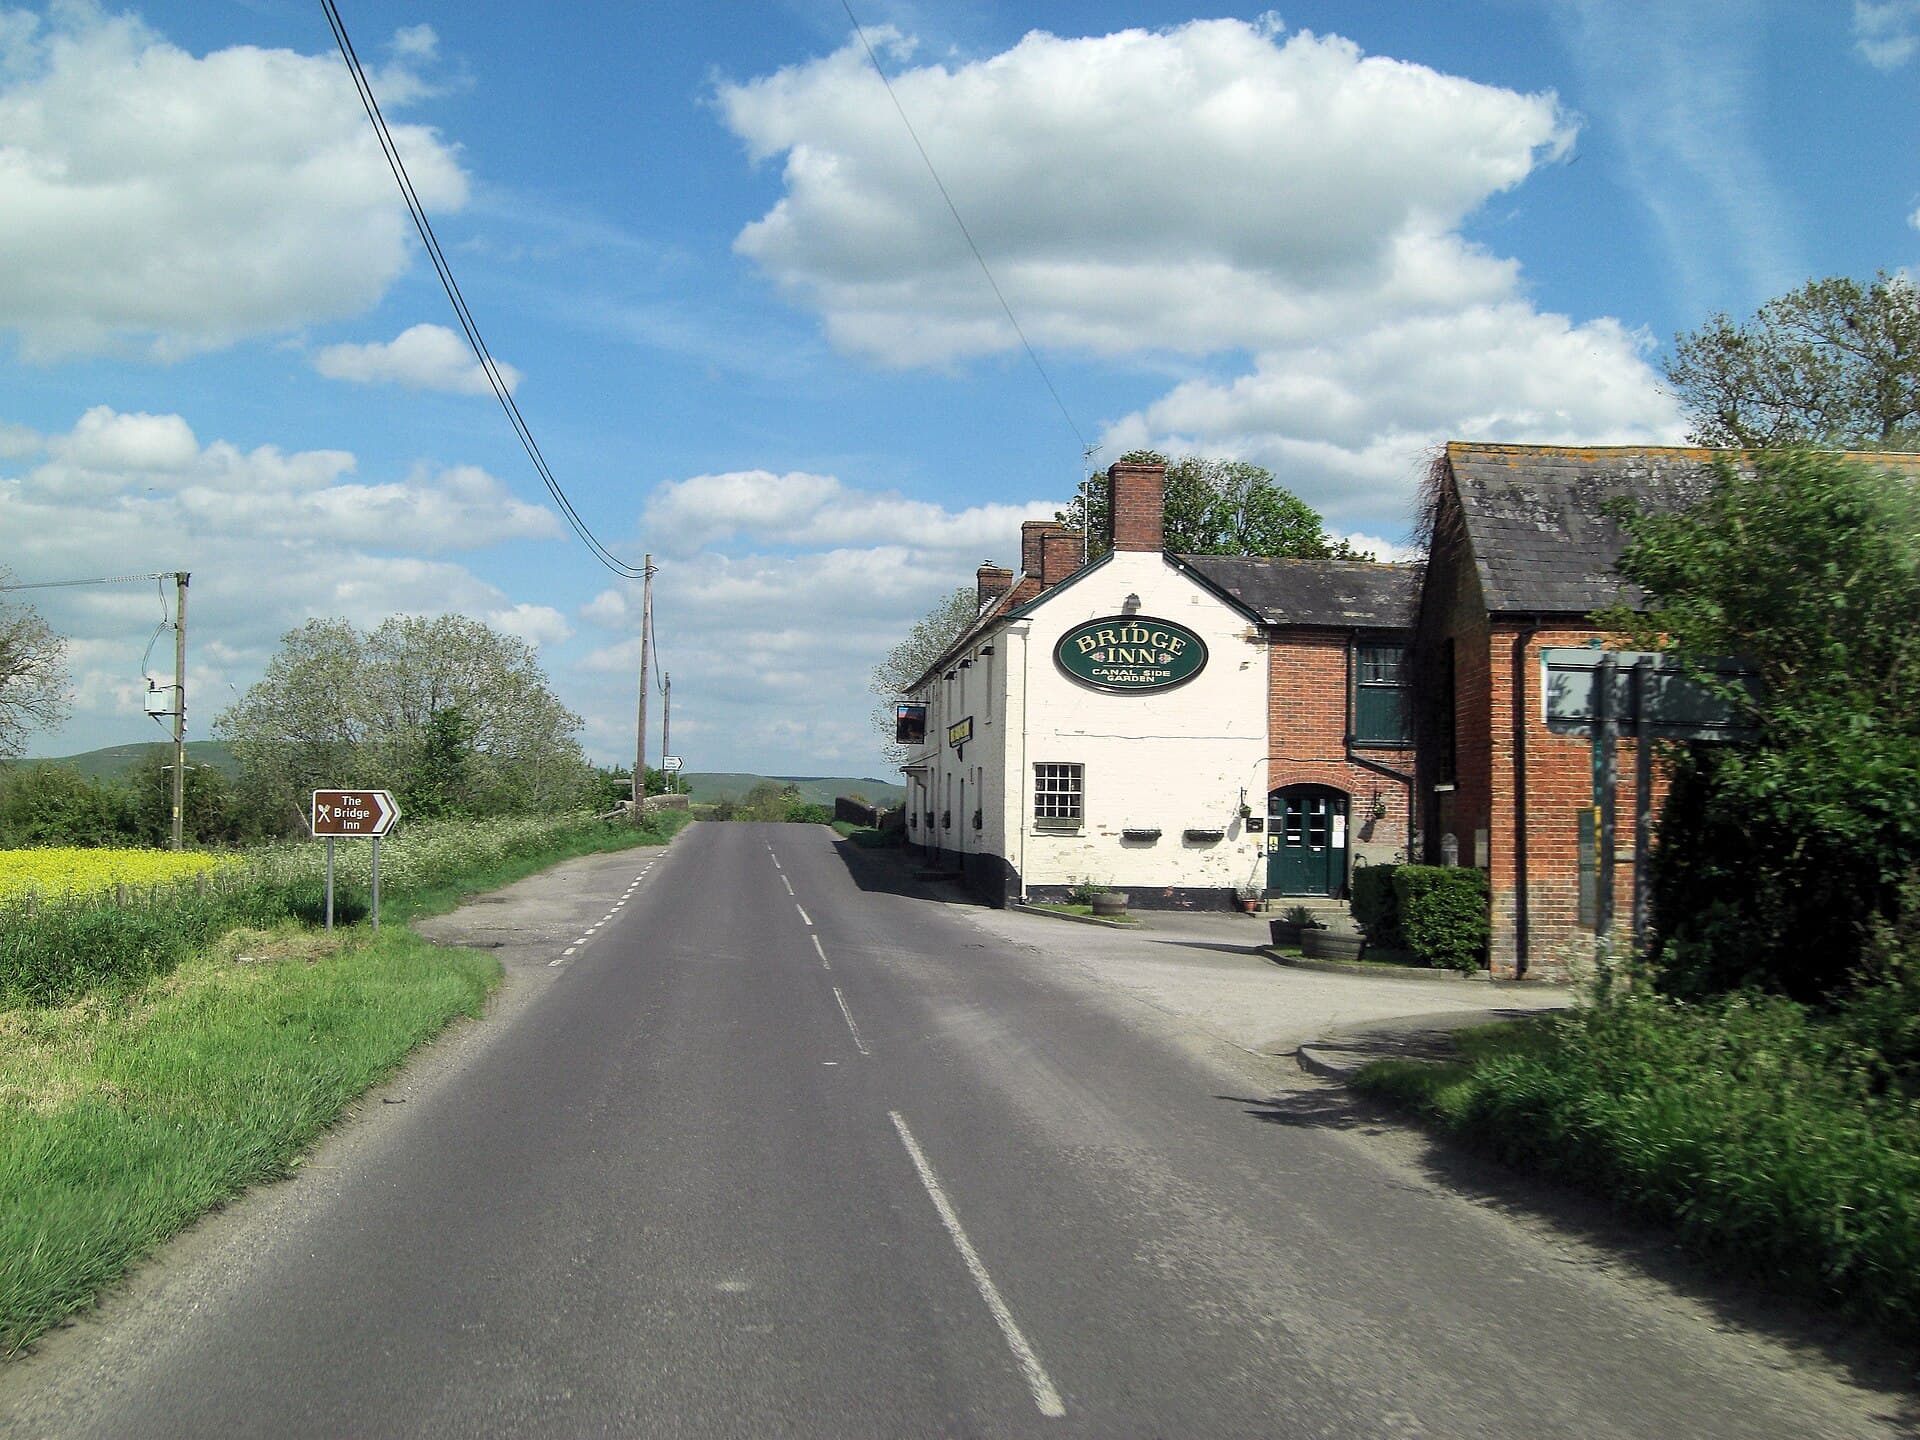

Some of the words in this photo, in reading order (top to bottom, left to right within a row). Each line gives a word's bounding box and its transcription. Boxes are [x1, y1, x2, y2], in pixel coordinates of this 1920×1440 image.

[1076, 628, 1186, 655] BRIDGE
[1106, 647, 1157, 664] INN
[1143, 669, 1171, 677] SIDE
[341, 795, 362, 805] The
[334, 808, 370, 819] Bridge
[343, 820, 360, 830] Inn
